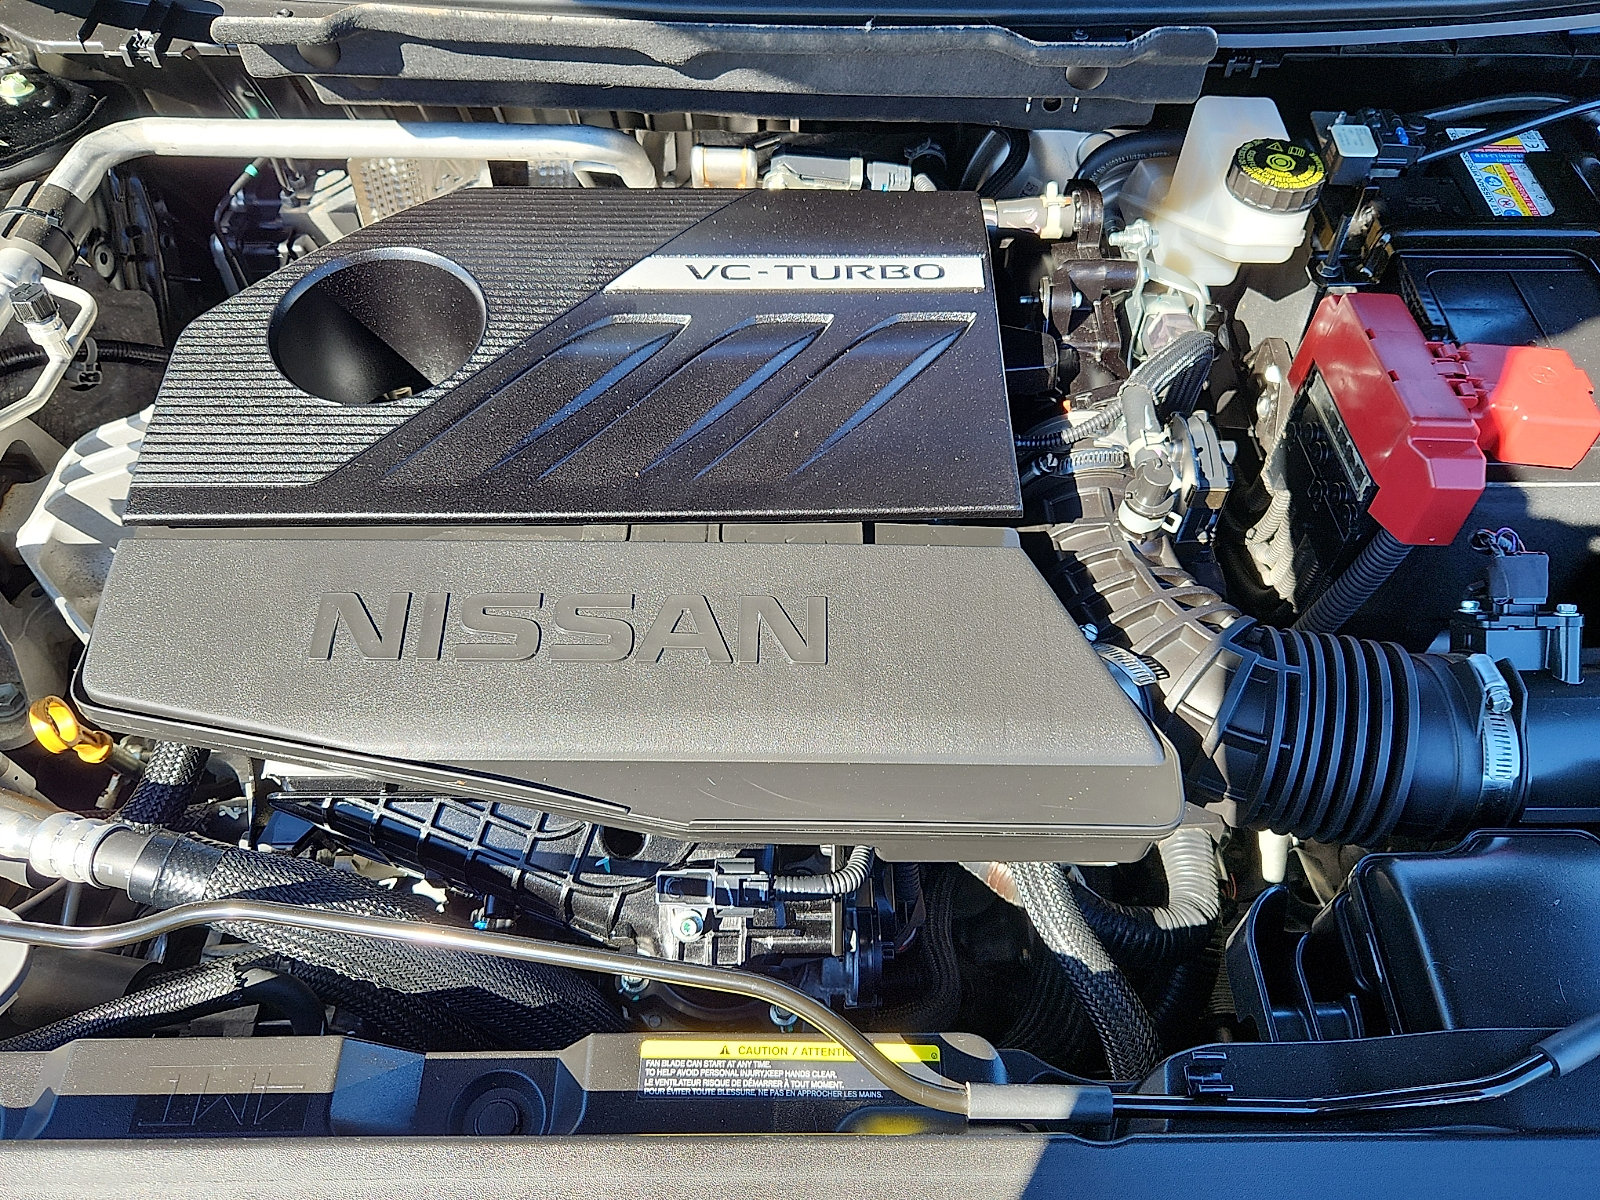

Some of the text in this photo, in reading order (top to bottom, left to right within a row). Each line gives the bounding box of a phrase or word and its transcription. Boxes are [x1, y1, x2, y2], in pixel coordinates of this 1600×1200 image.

[685, 264, 946, 281] VC-TURBO
[308, 591, 829, 665] NISSAN
[738, 1046, 788, 1056] CAUTION
[646, 1059, 772, 1069] FAN BLADE CAN START AT ANY TIME.
[645, 1068, 656, 1077] TO
[657, 1068, 676, 1077] HELP
[676, 1069, 700, 1077] AVOID
[700, 1069, 740, 1078] PERSONAL
[785, 1070, 811, 1079] HANDS
[811, 1070, 838, 1079] CLEAR.
[644, 1077, 845, 1090] LE VENTILATEUR RISQUE DE DÉMARRER À TOUT MOMENT.
[644, 1086, 884, 1099] POUR ÉVITER TOUTE BLESSURE, NE PAS EN APPROCHER LES MAINS.
